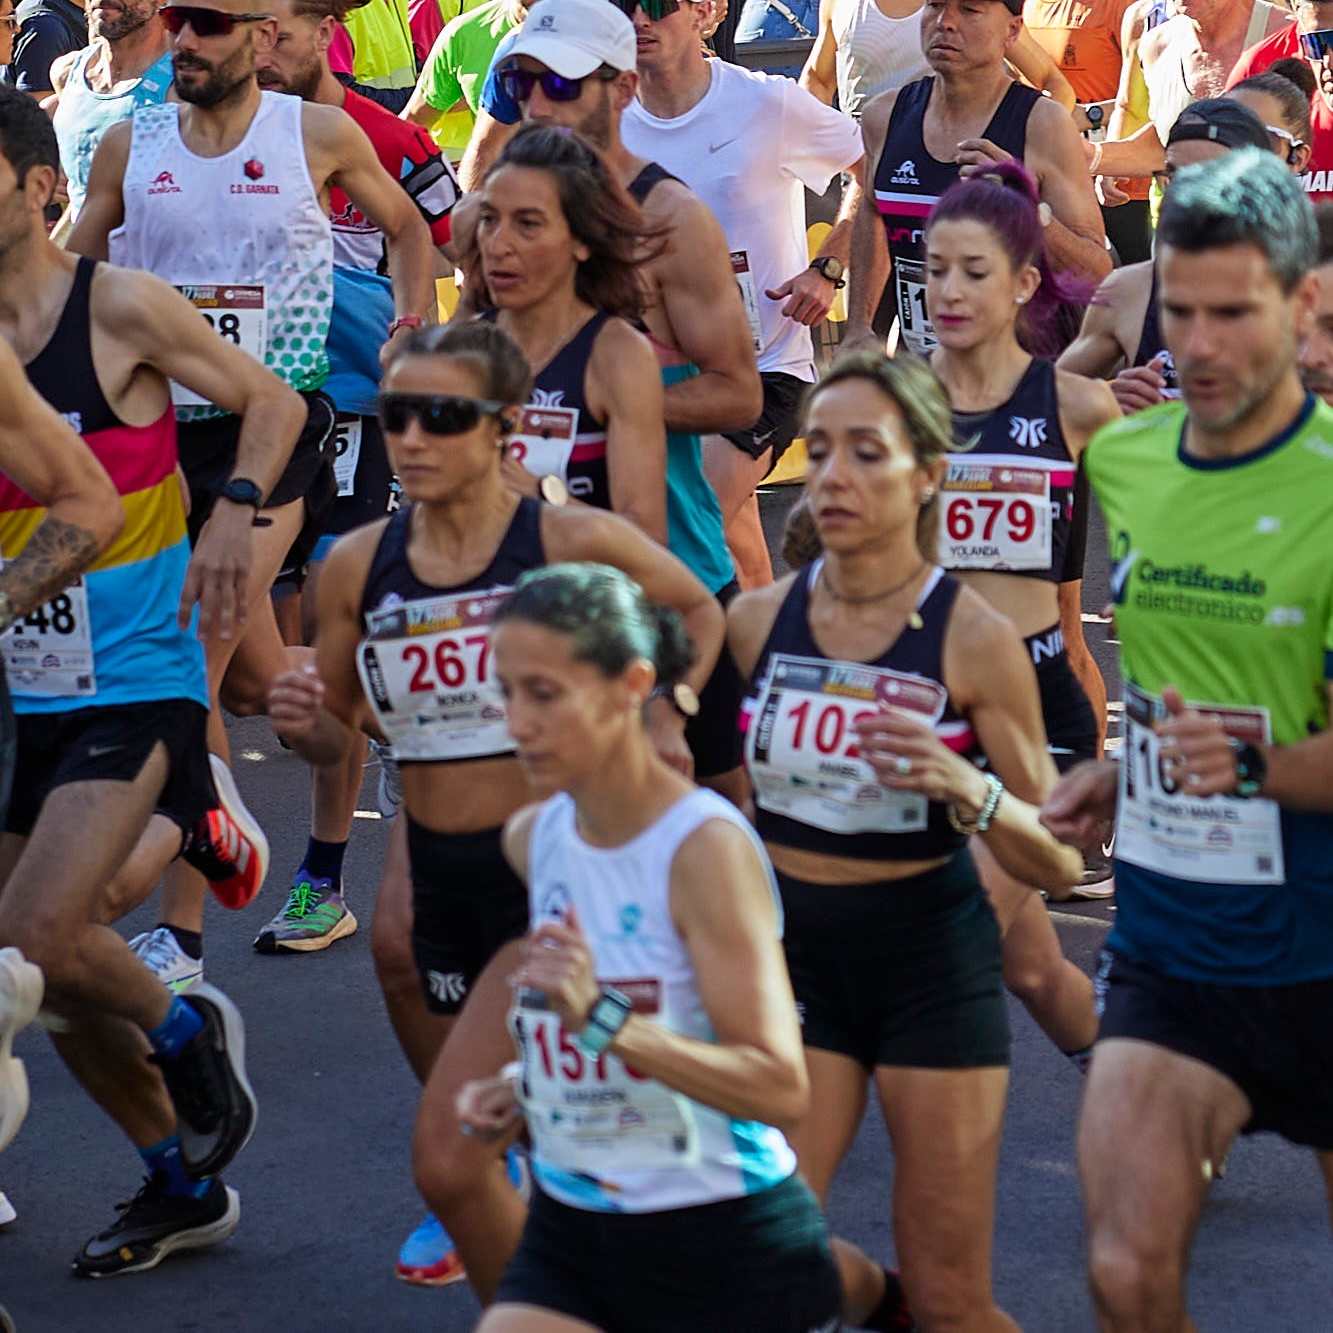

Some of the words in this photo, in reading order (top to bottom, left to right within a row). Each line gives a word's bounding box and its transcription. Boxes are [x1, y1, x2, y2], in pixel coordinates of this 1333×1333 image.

[246, 184, 280, 195] GARNATA
[201, 313, 240, 347] 8
[947, 498, 1035, 543] 679
[950, 546, 1000, 556] YOLANDA
[1138, 562, 1266, 596] Certificado
[14, 593, 75, 635] 48
[402, 634, 490, 693] 267
